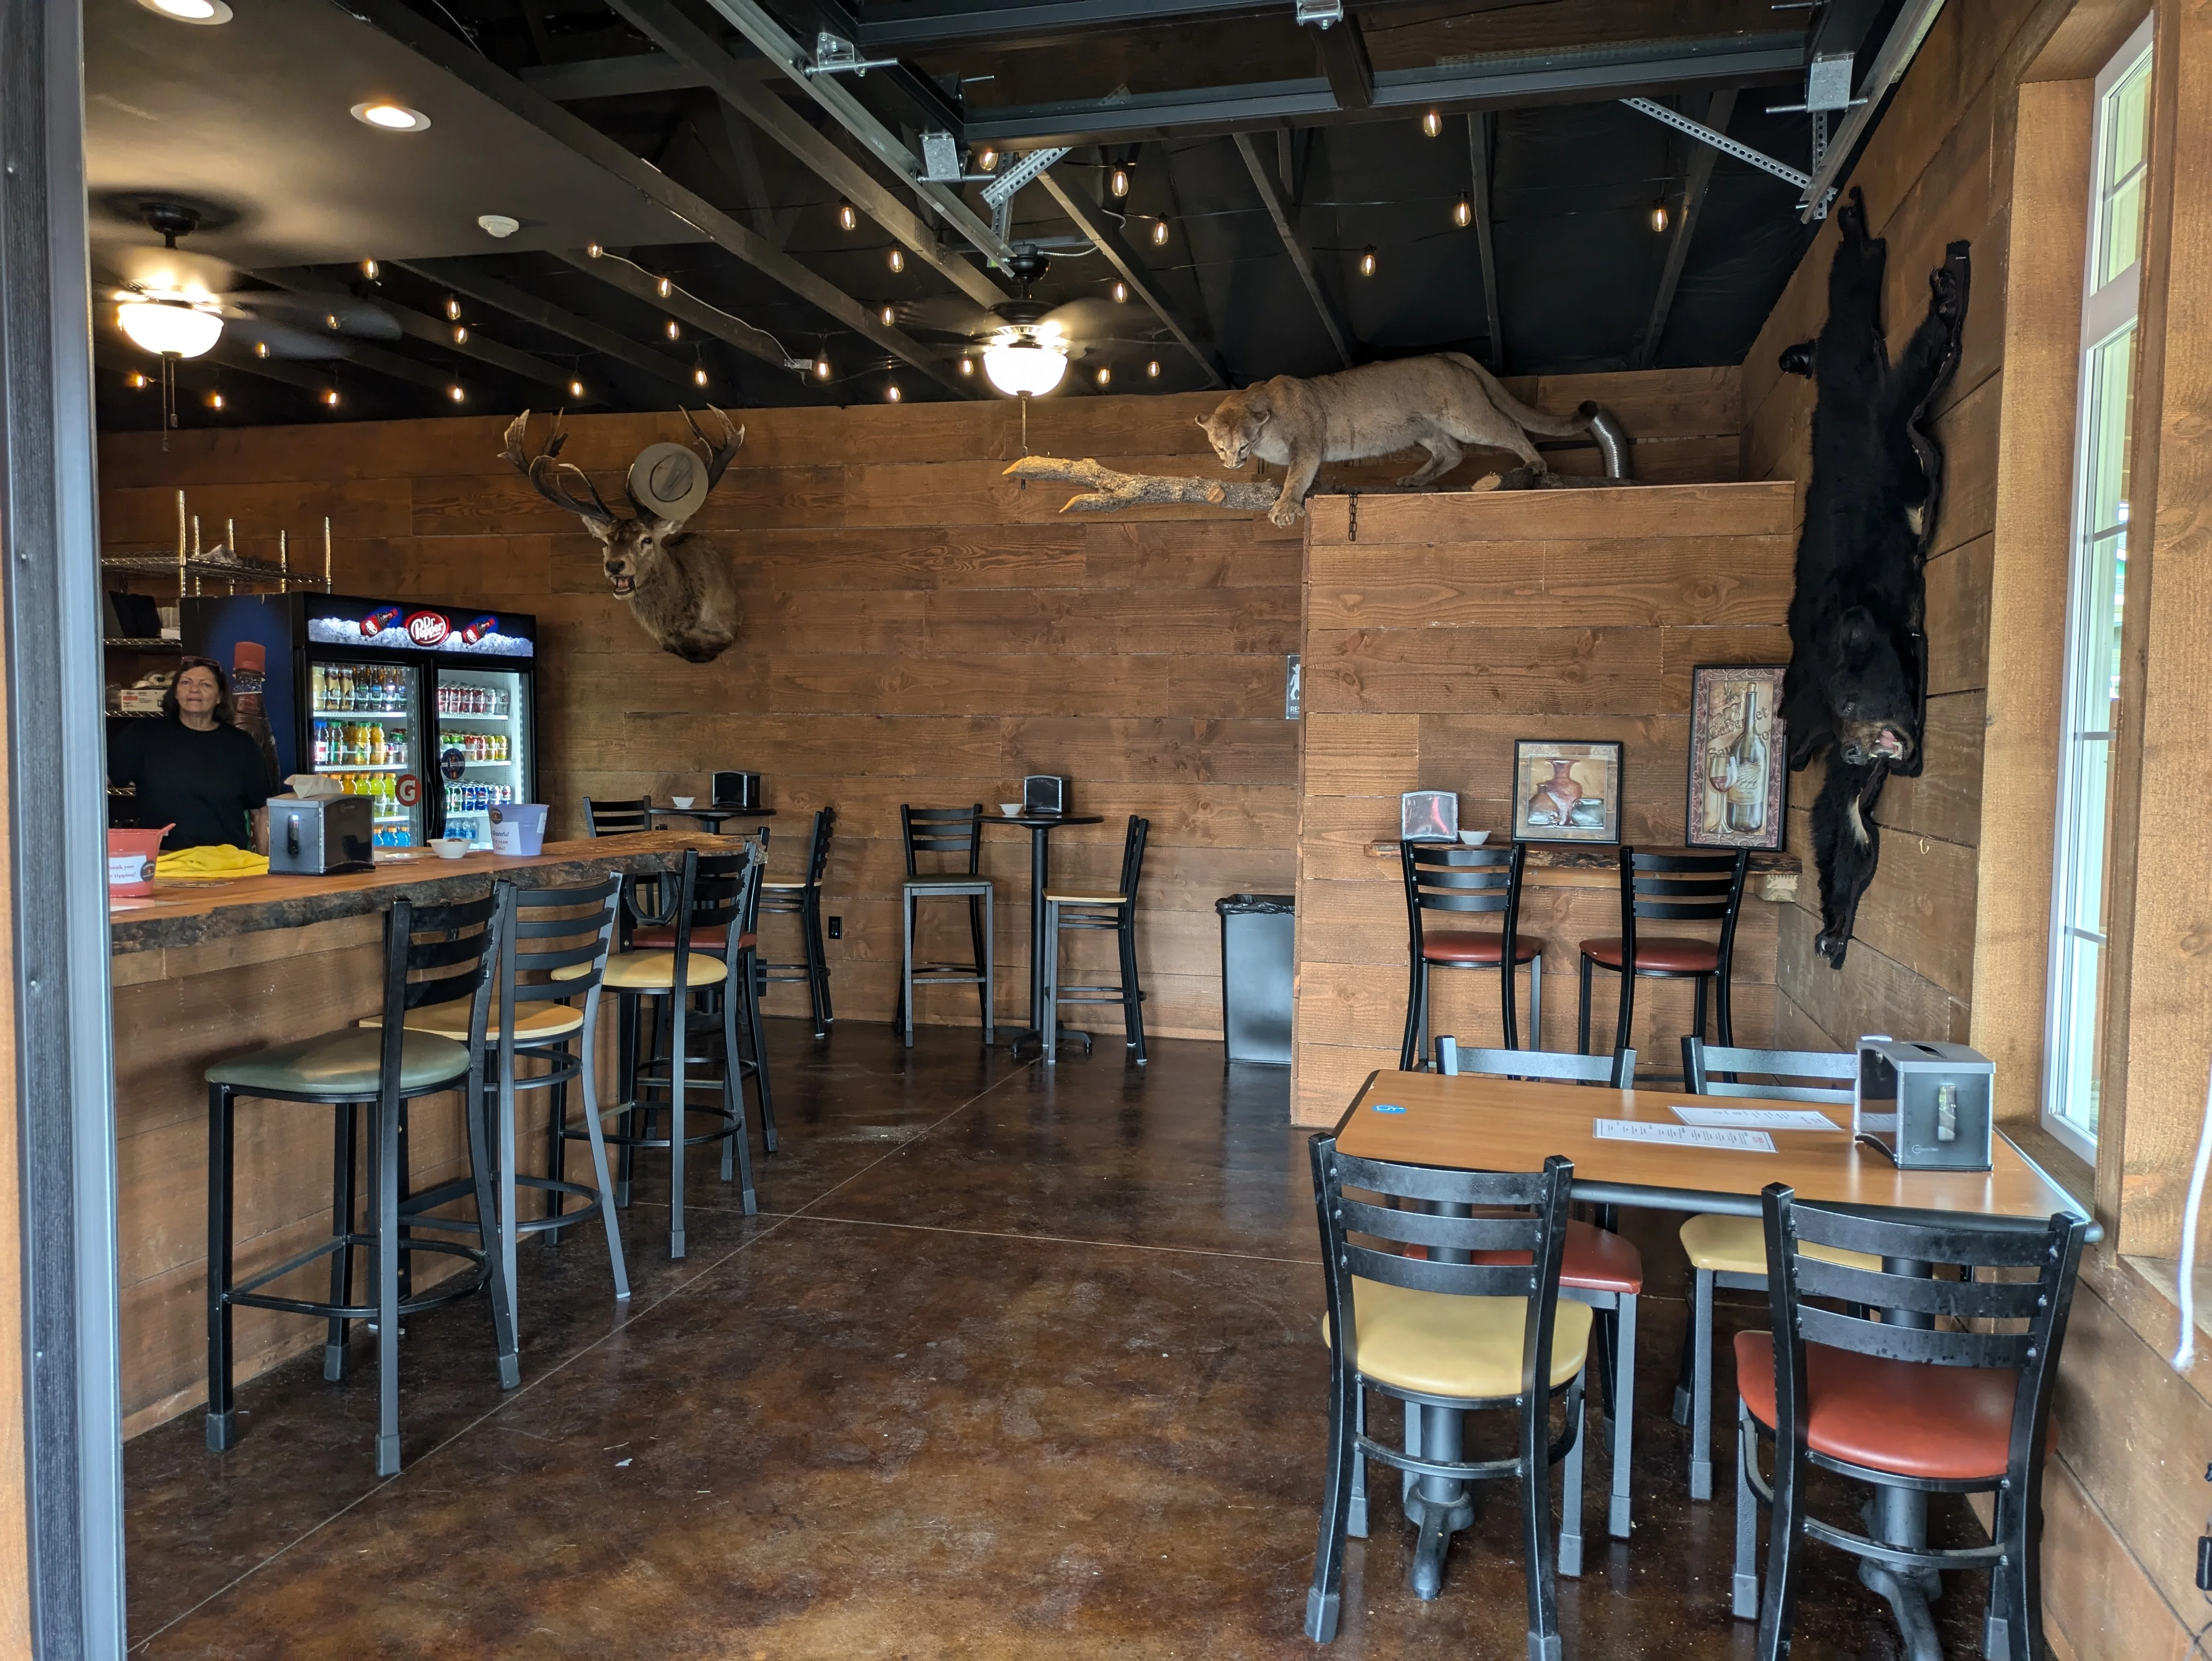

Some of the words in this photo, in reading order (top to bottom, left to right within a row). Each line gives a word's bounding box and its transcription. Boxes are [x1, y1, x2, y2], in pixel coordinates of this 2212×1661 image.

[411, 619, 443, 640] Pepper
[423, 616, 435, 629] Dr
[400, 780, 415, 801] G
